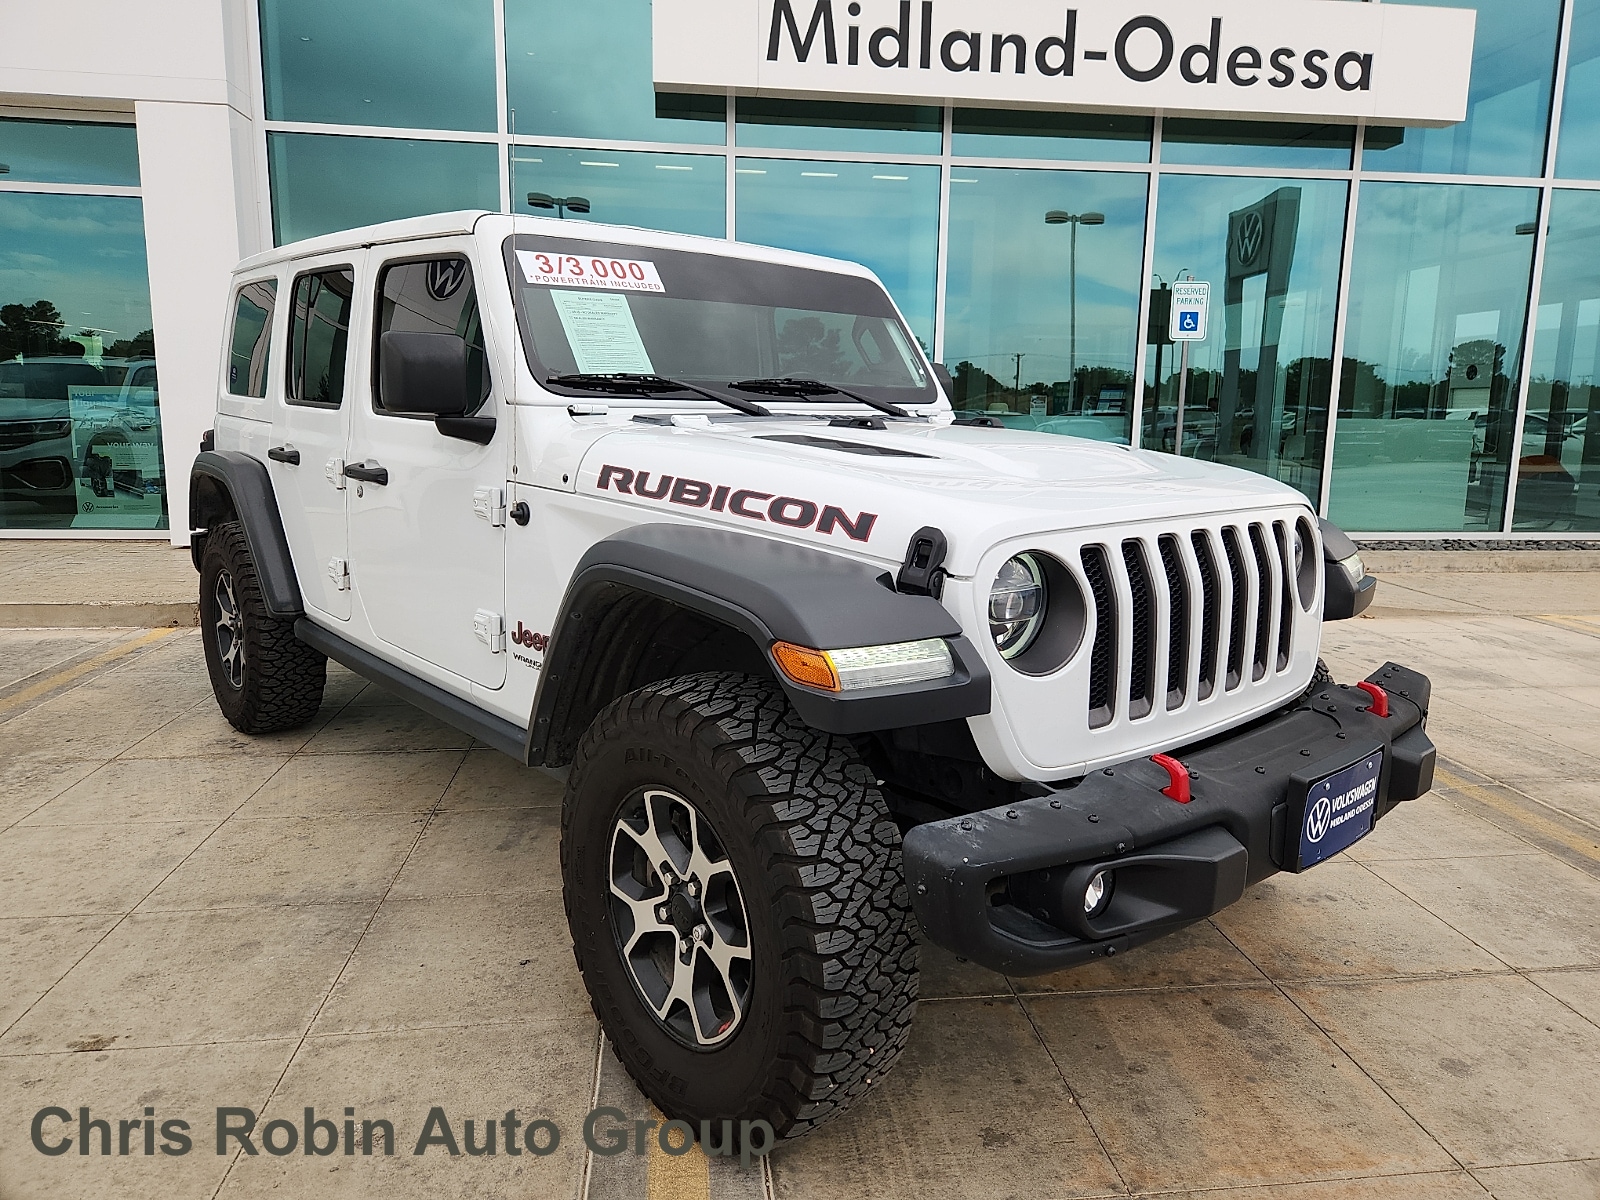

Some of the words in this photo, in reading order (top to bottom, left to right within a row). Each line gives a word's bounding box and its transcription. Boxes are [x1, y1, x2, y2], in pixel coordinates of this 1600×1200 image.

[767, 0, 1374, 91] Midland-Odessa
[610, 281, 661, 291] INCLUDED
[1175, 287, 1207, 296] RESERVED
[1176, 297, 1204, 305] PARKING
[596, 463, 878, 543] RUBICON
[512, 651, 542, 668] WRANG
[1332, 776, 1377, 813] VOLKSWAGEN
[1330, 808, 1356, 829] MIDLAND
[1355, 797, 1374, 815] ODESSA
